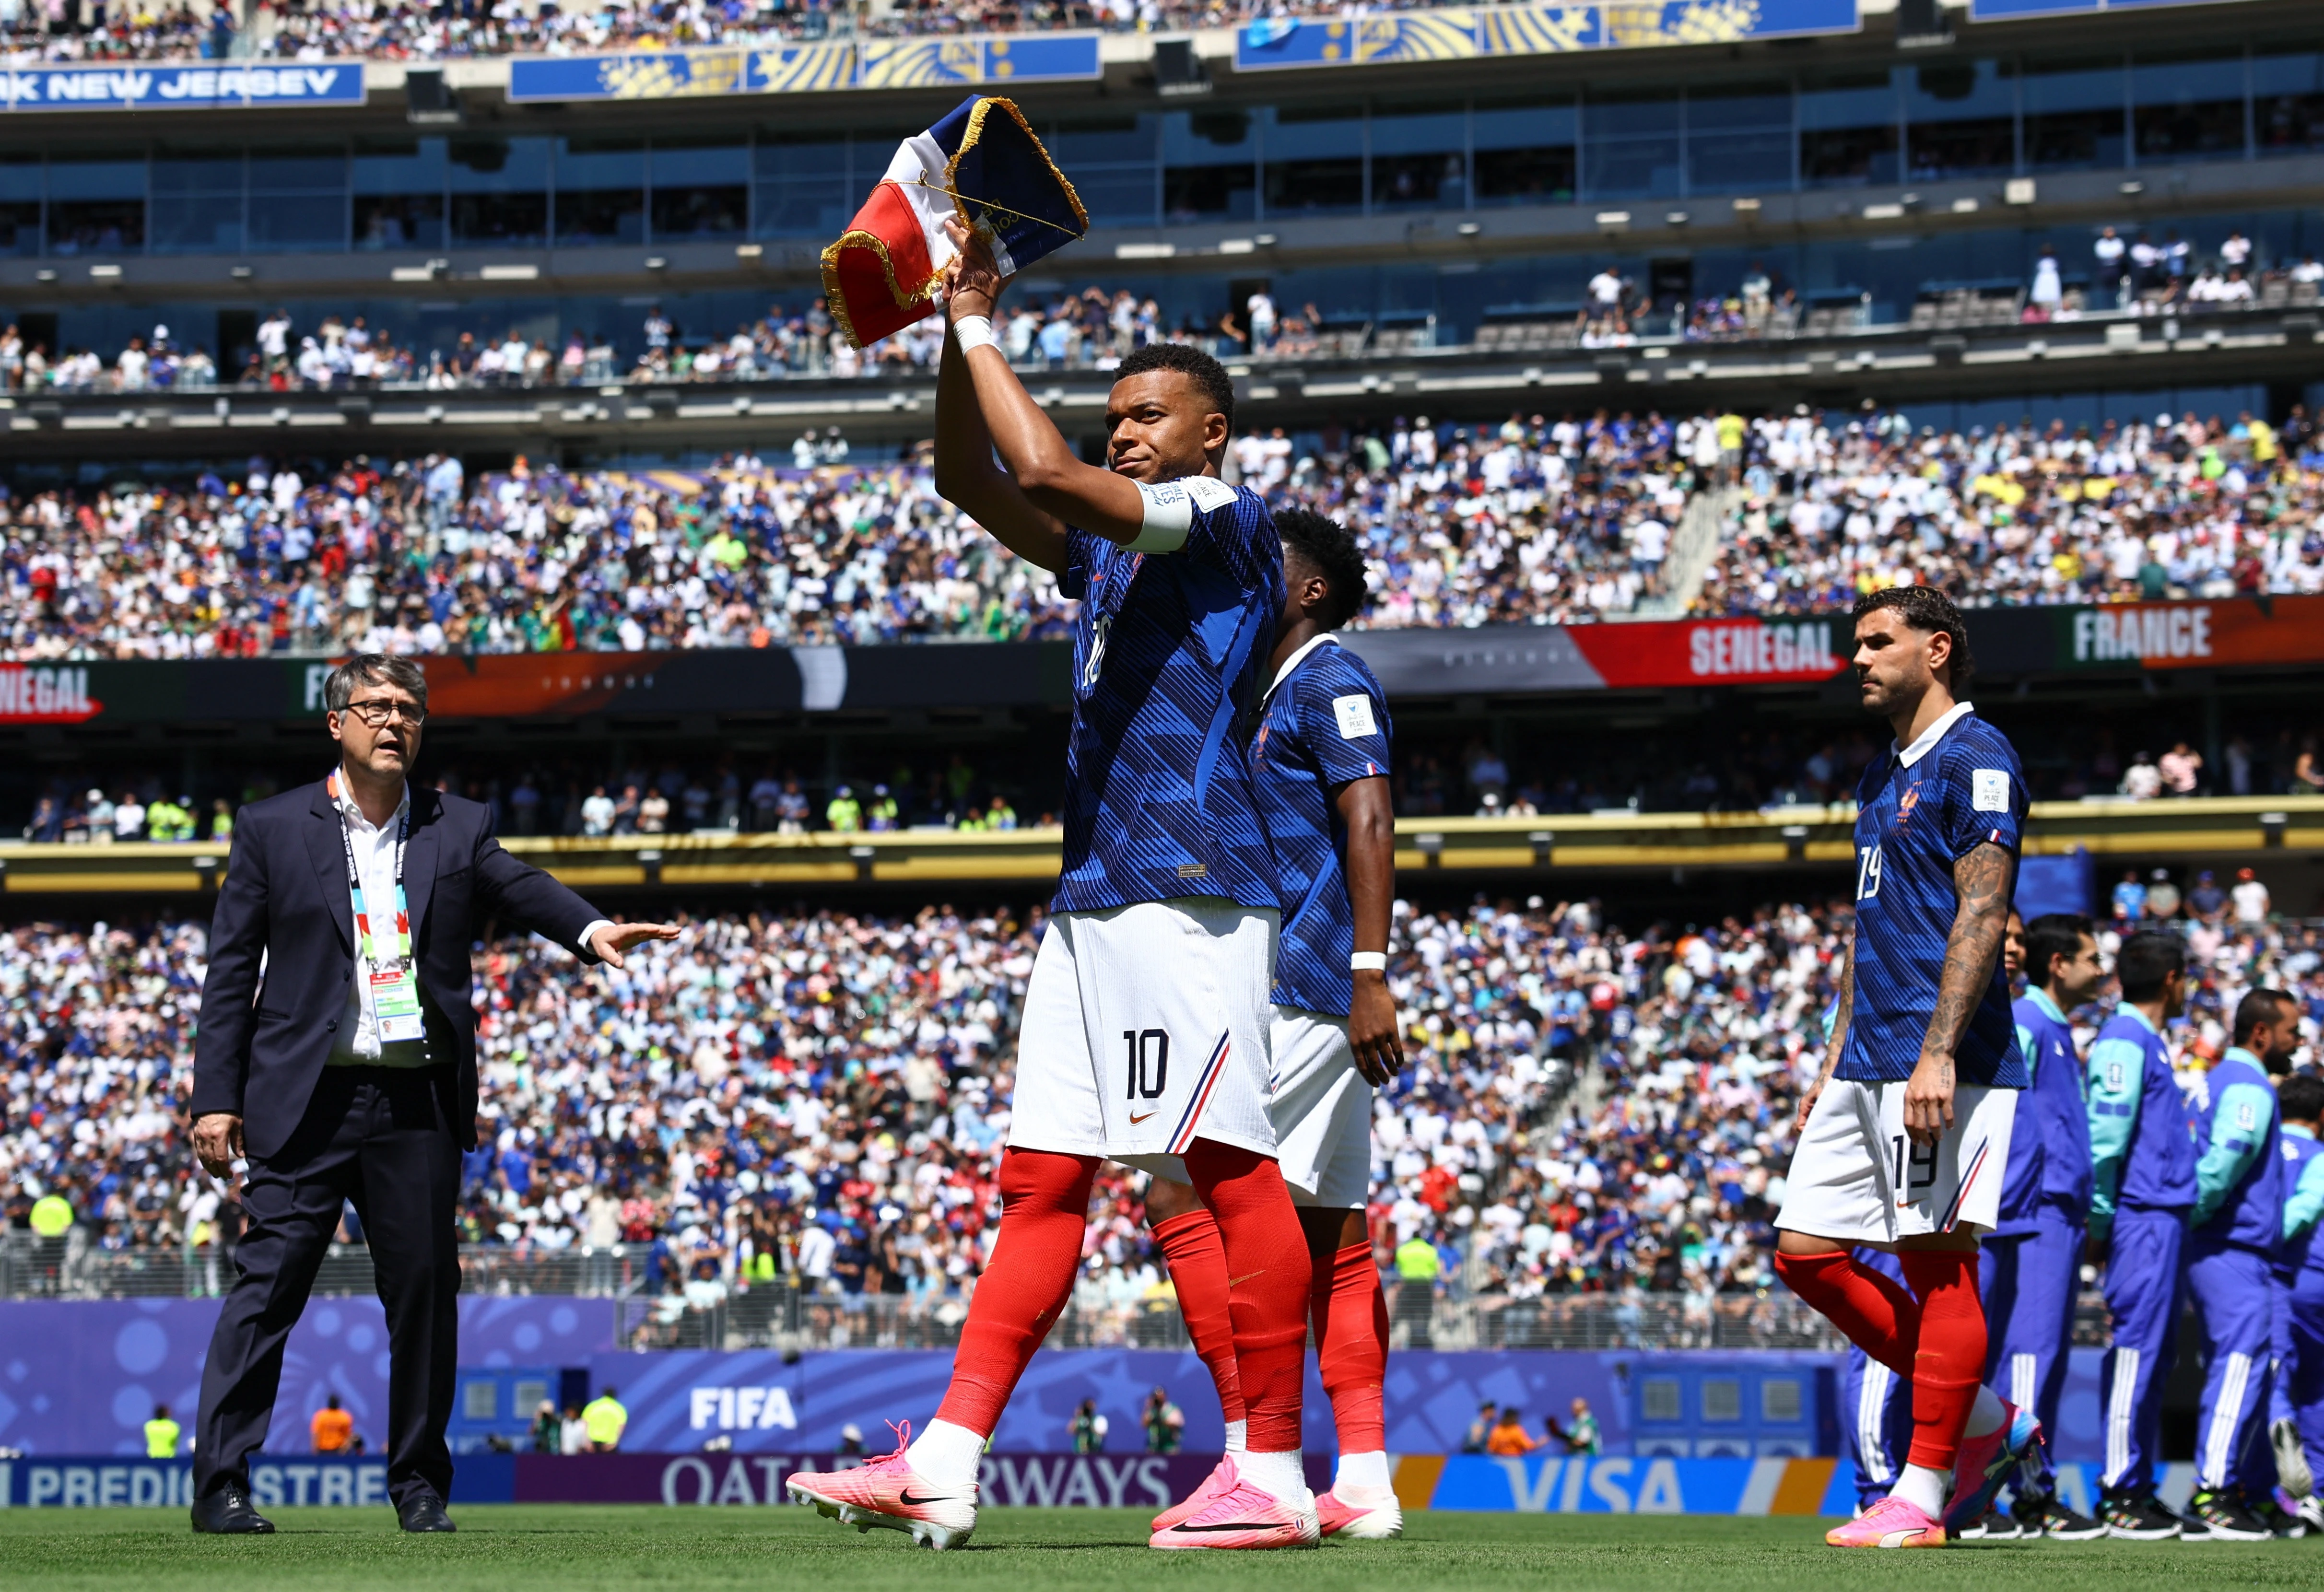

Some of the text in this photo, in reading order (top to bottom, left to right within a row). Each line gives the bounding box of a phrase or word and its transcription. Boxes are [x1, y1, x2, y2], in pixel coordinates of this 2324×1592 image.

[47, 70, 153, 100] NEW
[157, 68, 338, 99] JERSEY
[1689, 622, 1837, 676] SENEGAL
[2073, 606, 2212, 661] FRANCE
[1349, 720, 1366, 728] PEACE
[1984, 795, 1999, 803] PEACE
[347, 855, 357, 883] 2026
[1856, 844, 1882, 901] 19
[1123, 1028, 1169, 1100] 10
[1892, 1133, 1939, 1189] 19
[690, 1386, 798, 1430] FIFA
[1490, 1457, 1686, 1515] VISA
